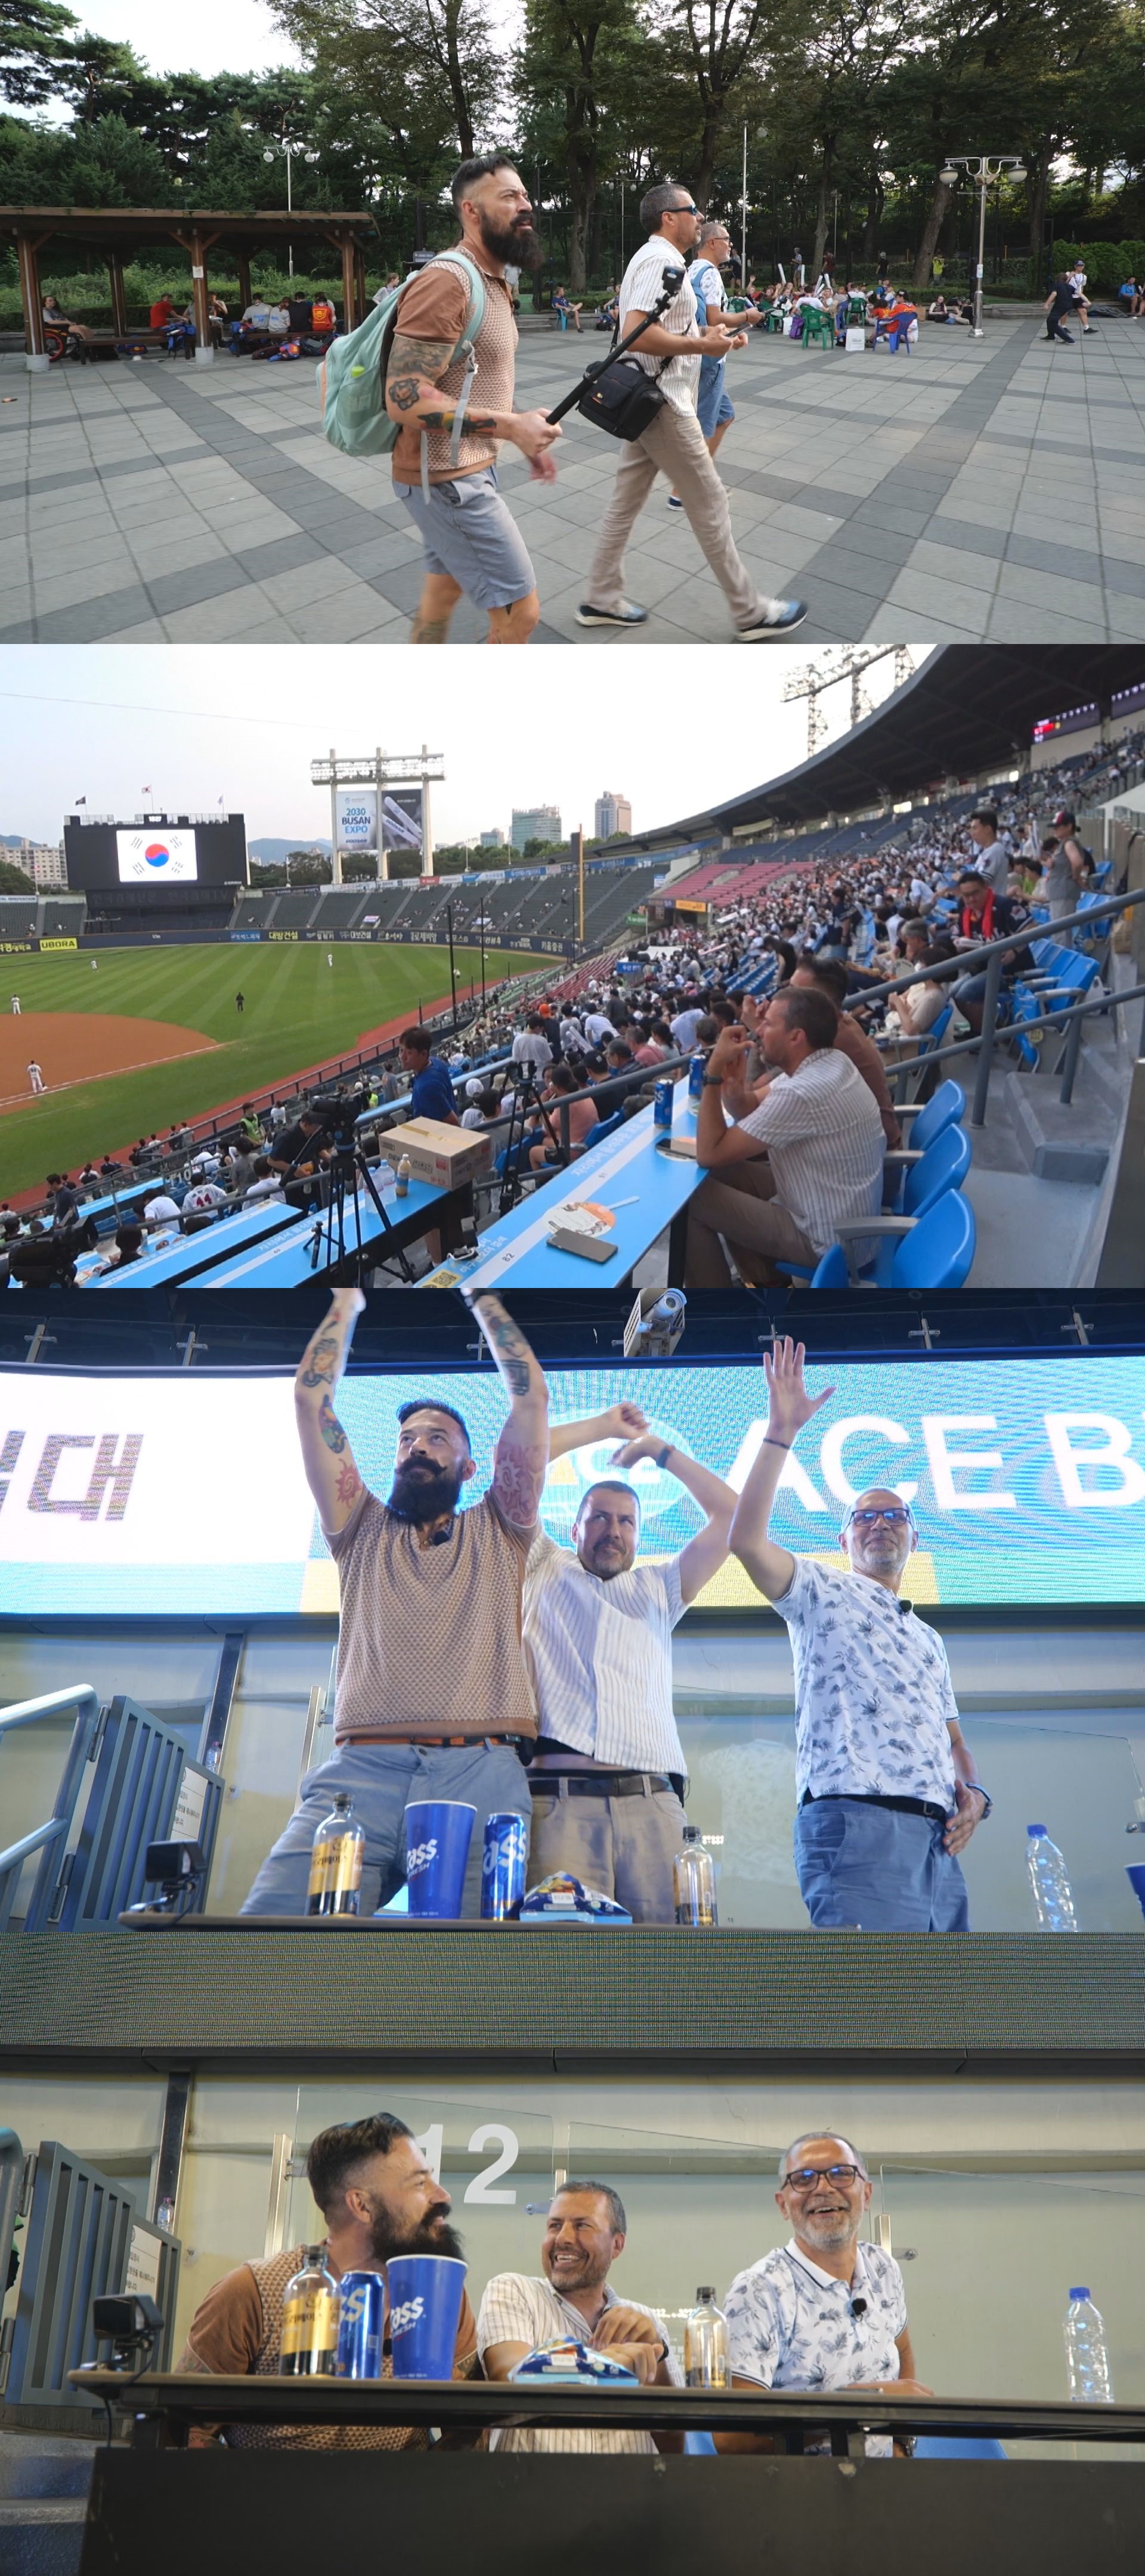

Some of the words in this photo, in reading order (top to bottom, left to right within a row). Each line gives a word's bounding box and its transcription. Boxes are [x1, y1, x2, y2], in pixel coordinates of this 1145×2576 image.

[342, 816, 371, 825] BUSAN
[345, 825, 368, 834] EXPO
[196, 1193, 212, 1207] 44
[501, 1252, 515, 1262] 82
[1044, 1412, 1145, 1507] B
